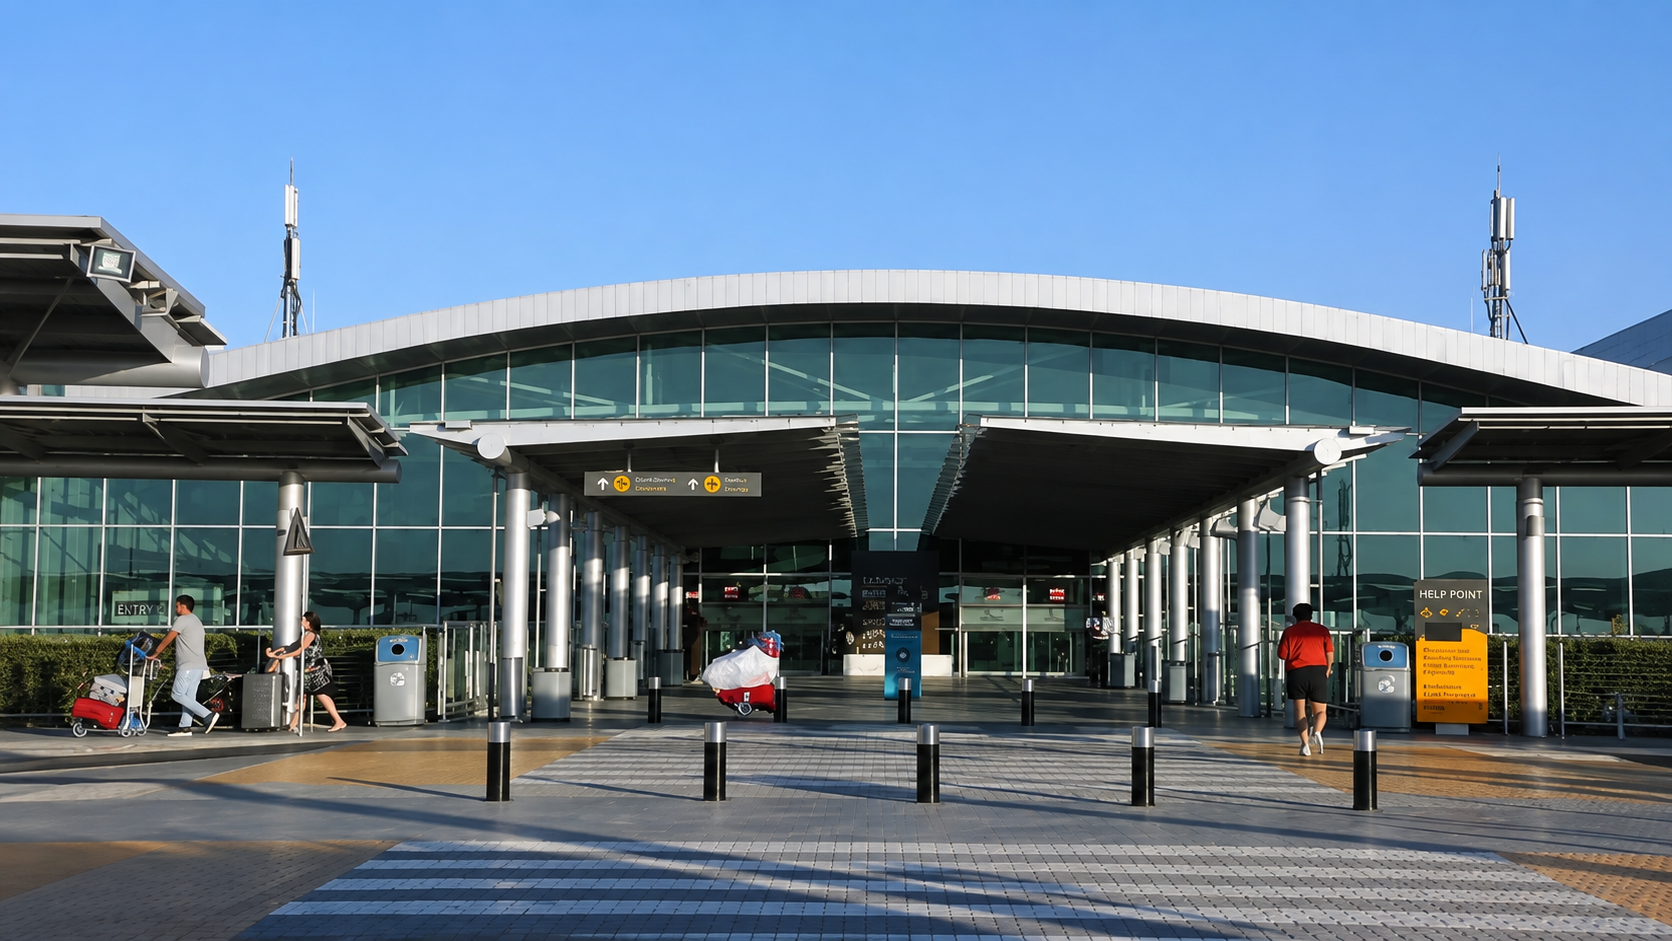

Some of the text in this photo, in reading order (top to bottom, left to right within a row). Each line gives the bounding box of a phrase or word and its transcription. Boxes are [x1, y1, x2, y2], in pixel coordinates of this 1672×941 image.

[1420, 590, 1482, 599] HELP POINT
[118, 604, 153, 615] ENTRY
